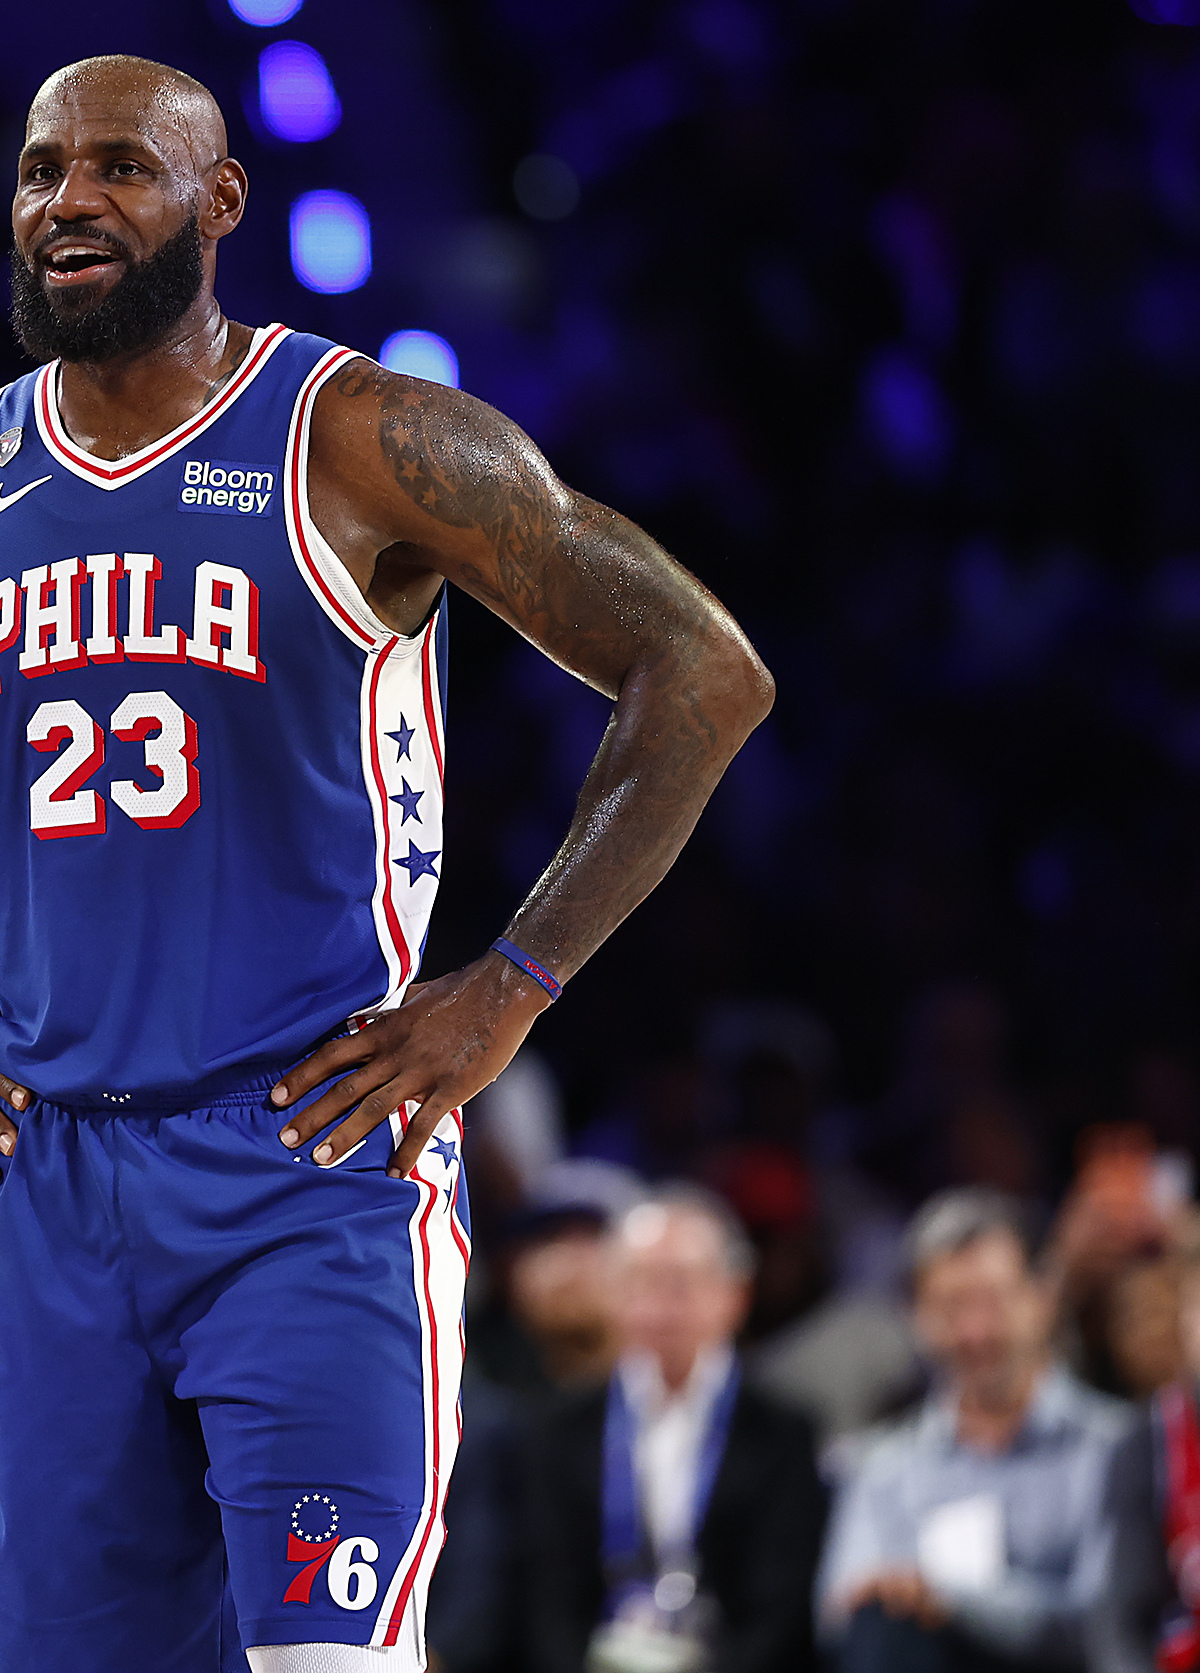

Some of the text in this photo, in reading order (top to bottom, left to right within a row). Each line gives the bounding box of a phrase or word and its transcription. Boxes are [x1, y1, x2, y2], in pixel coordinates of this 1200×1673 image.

[181, 487, 272, 513] energy
[184, 461, 274, 490] Bloom
[26, 690, 201, 840] 23
[283, 1532, 380, 1611] 76
